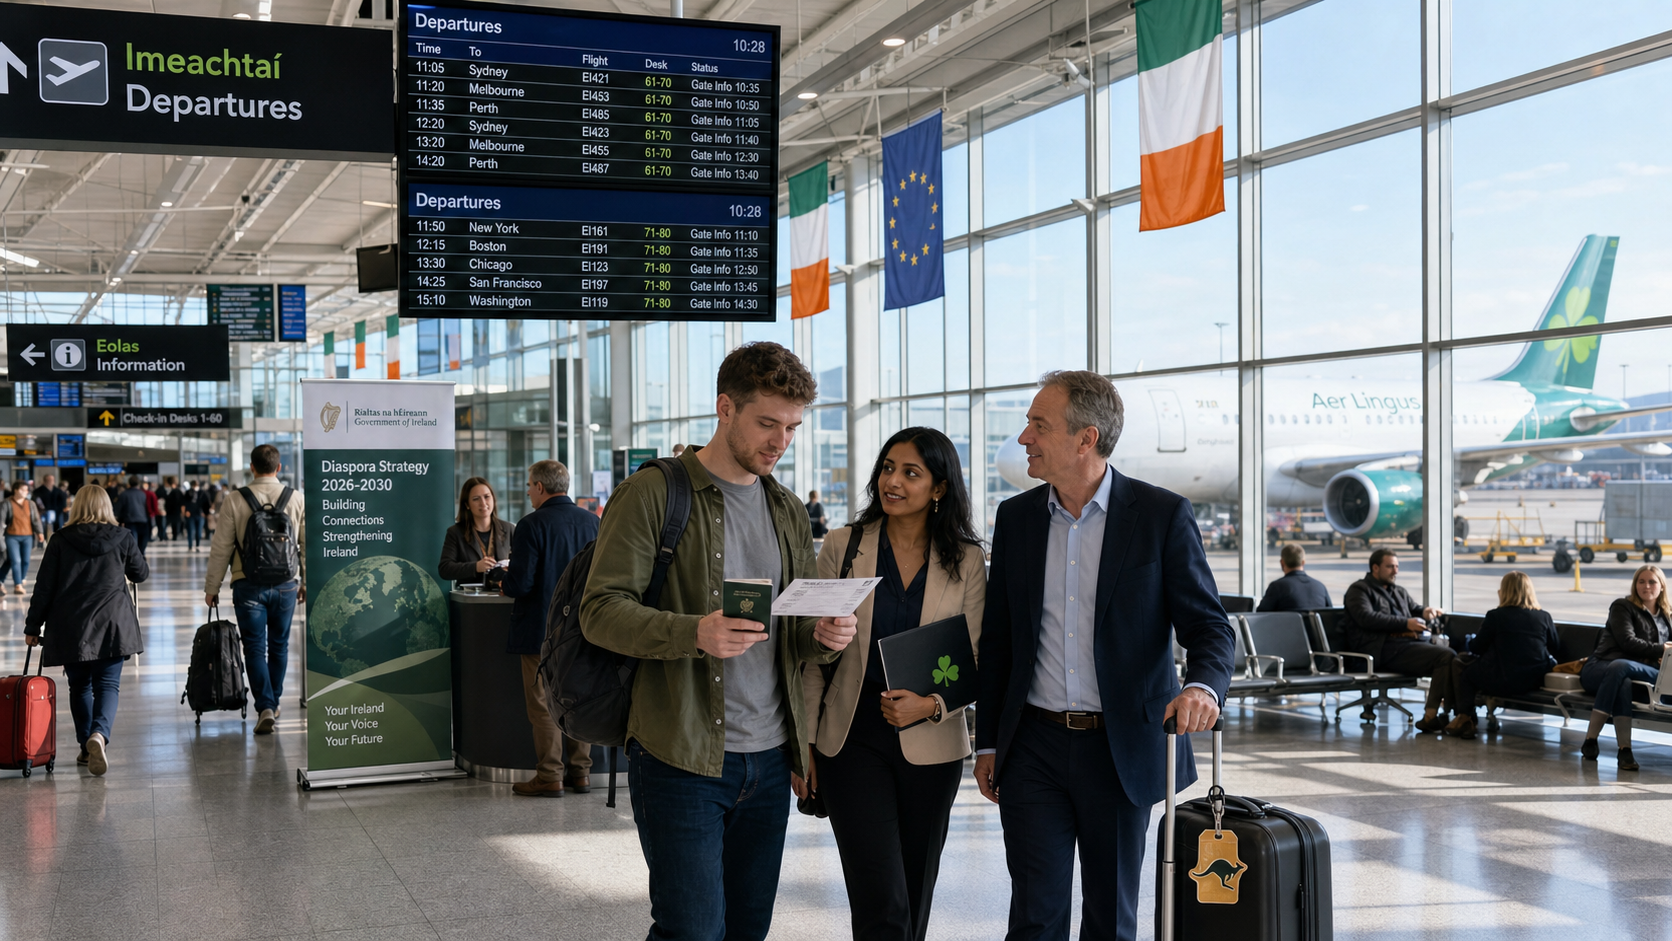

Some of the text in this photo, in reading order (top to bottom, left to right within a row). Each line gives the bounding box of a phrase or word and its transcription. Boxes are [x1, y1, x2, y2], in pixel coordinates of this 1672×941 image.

[416, 13, 502, 35] Departures
[733, 39, 765, 53] 10:28
[126, 42, 282, 79] Imeachtaí
[416, 43, 718, 73] Time To Flight Desk Status
[416, 61, 759, 93] 11:05 Sydney EI421 61-70 Gate Info 10:35
[126, 83, 302, 122] Departures
[416, 79, 759, 111] 11:20 Melbourne EI453 61-70 Gate Info 10:50
[416, 98, 759, 128] 11:35 Perth EI485 61-70 Gate Info 11:05
[416, 118, 759, 145] 12:20 Sydney EI423 61-70 Gate Info 11:40
[416, 136, 759, 163] 13:20 Melbourne EI455 61-70 Gate Info 12:30
[416, 154, 759, 180] 14:20 Perth EI487 61-70 Gate Info 13:40
[416, 192, 501, 211] Departures
[729, 205, 762, 218] 10:28
[416, 221, 758, 240] 11:50 New York EI161 71-80 Gate Info 11:10
[416, 239, 758, 258] 12:15 Boston EI191 71-80 Gate Info 11:35
[416, 258, 758, 275] 13:30 Chicago EI123 71-80 Gate Info 12:50
[416, 276, 758, 293] 14:25 San Francisco EI197 71-80 Gate Info 13:45
[416, 294, 758, 310] 15:10 Washington EI119 71-80 Gate Info 14:30
[97, 339, 139, 353] Eolas
[97, 358, 185, 371] Information
[1312, 392, 1421, 415] Aer Lingus
[123, 413, 222, 423] Check-in Desks 1-60
[402, 418, 410, 428] of
[322, 460, 429, 475] Diaspora Strategy
[323, 499, 365, 512] Building
[323, 515, 384, 526] Connections
[323, 531, 392, 543] Strengthening
[323, 546, 358, 557] Ireland
[325, 703, 384, 716] Your Ireland
[325, 719, 378, 731] Your Voice
[325, 734, 383, 746] Your Future
